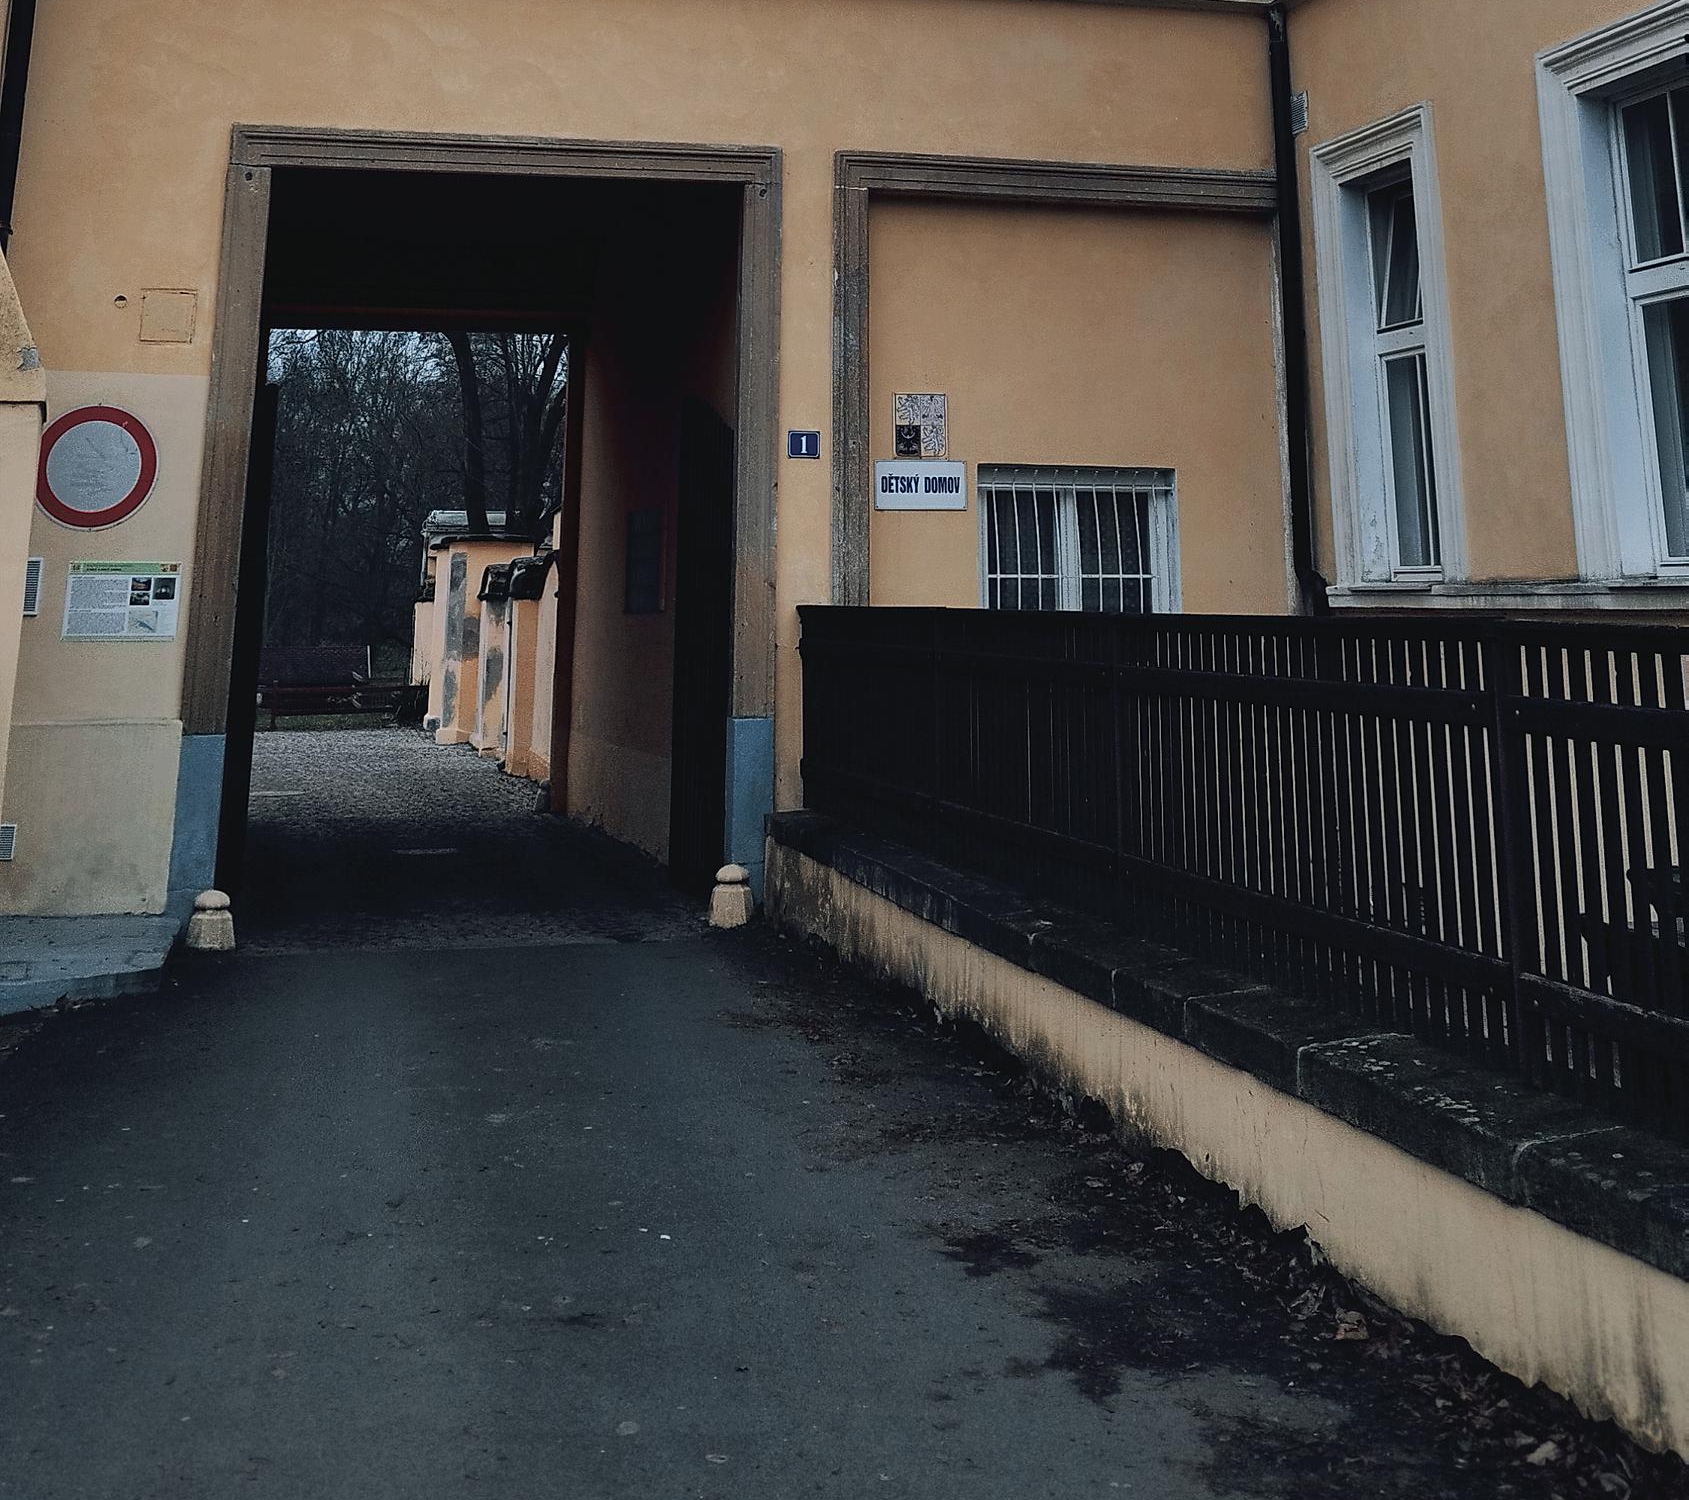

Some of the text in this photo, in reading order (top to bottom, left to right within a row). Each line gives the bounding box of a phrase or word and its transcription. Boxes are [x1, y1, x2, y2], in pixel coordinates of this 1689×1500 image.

[800, 435, 808, 454] 1
[881, 473, 960, 494] DĚTSKÝ DOMOV
